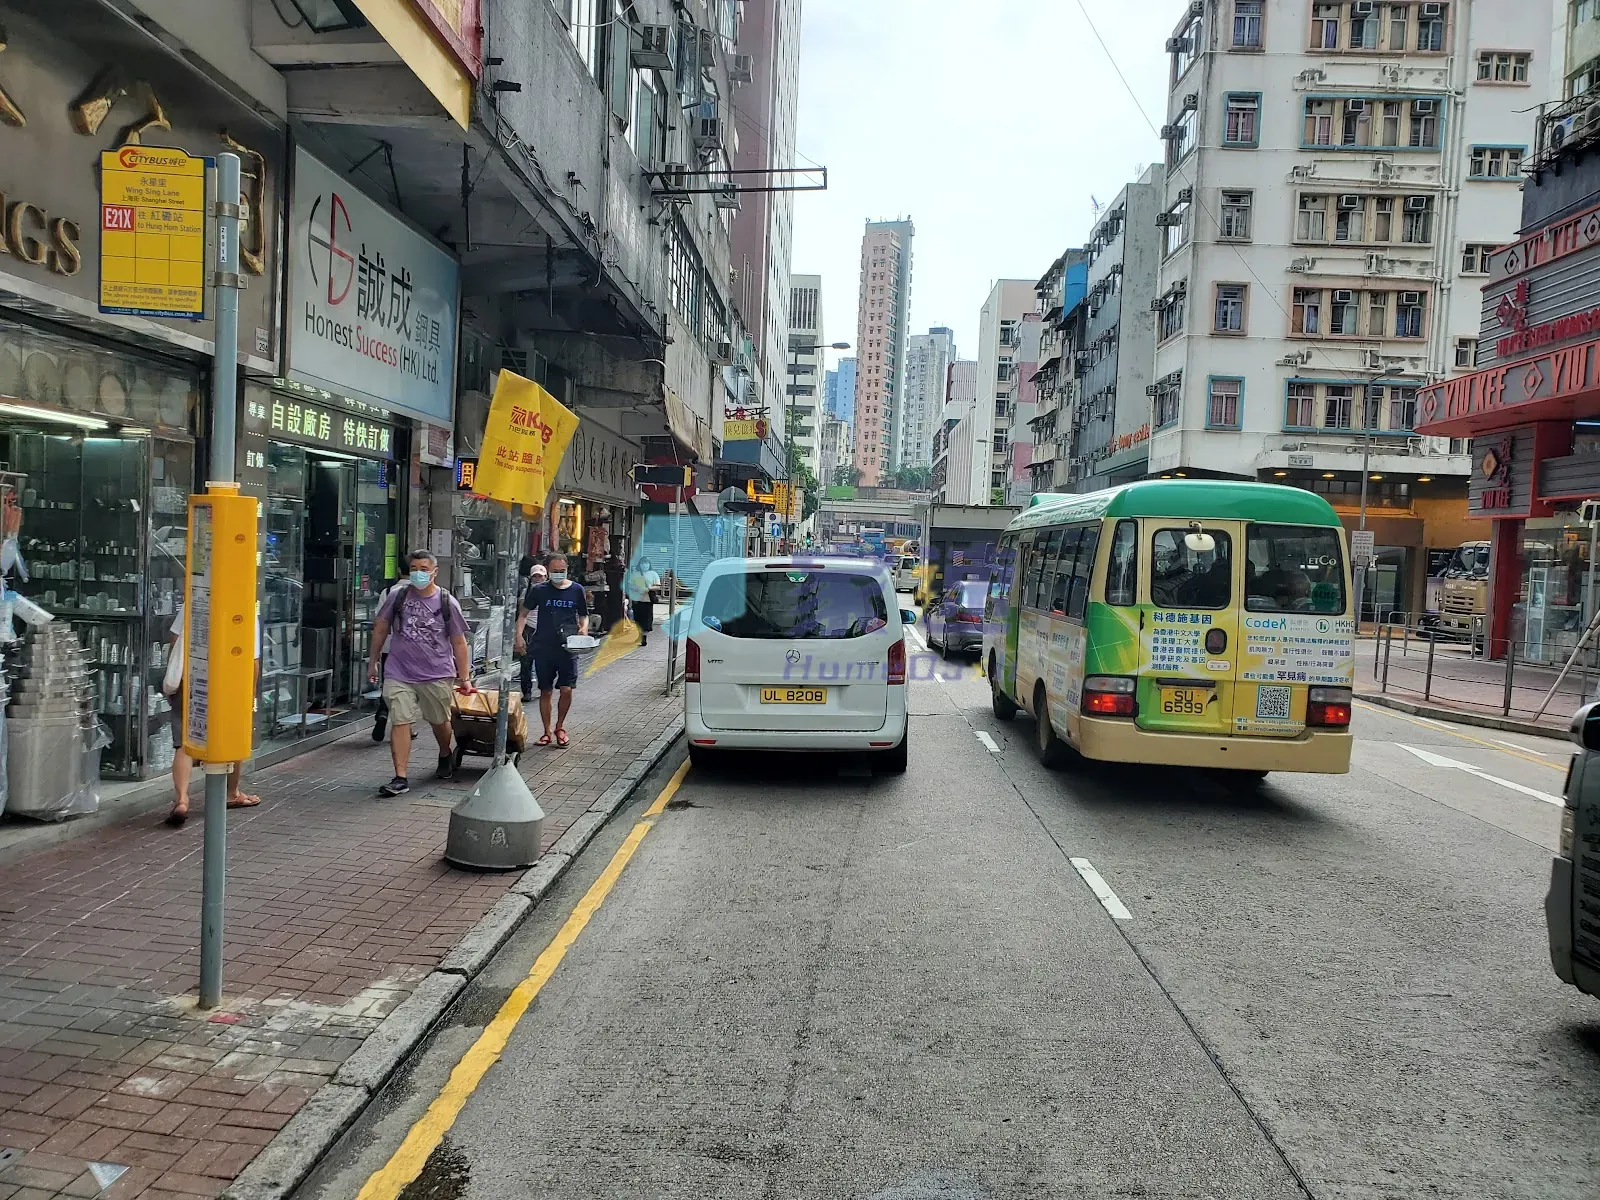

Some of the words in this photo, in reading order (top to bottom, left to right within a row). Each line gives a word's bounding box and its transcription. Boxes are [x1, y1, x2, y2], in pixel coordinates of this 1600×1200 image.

[129, 155, 169, 165] CITYBUS
[140, 176, 167, 188] 永星里
[125, 186, 143, 196] Wing
[145, 187, 160, 197] Sing
[162, 188, 180, 197] Lane
[141, 196, 167, 205] Shanghai
[168, 198, 185, 206] Street
[105, 207, 132, 229] E21X
[145, 221, 163, 231] Hung
[163, 224, 179, 232] Hom
[180, 224, 202, 233] Station
[1551, 219, 1582, 259] KEE
[357, 242, 413, 343] 誠成
[139, 309, 194, 319] www.citybus.com.hk
[305, 300, 354, 350] Honest
[356, 324, 398, 368] Success
[399, 343, 420, 380] (HK)
[422, 354, 439, 386] Ltd.
[1443, 376, 1475, 420] YIU
[1474, 367, 1509, 414] KEE
[1549, 344, 1588, 395] YIU
[271, 399, 331, 441] 自設廠房
[343, 417, 390, 452] 特快訂做
[503, 463, 515, 472] stop
[1481, 490, 1495, 509] YIU
[1494, 487, 1509, 509] KEE
[545, 599, 575, 608] AIGLE
[1153, 611, 1212, 625] 科德施基因
[1245, 617, 1287, 630] CodeX
[1152, 654, 1206, 664] 科學研究及基因
[1276, 670, 1307, 682] 罕見病
[764, 690, 782, 701] UL
[786, 690, 824, 702] 8208
[1174, 690, 1194, 702] SU
[1163, 700, 1204, 714] 6599
